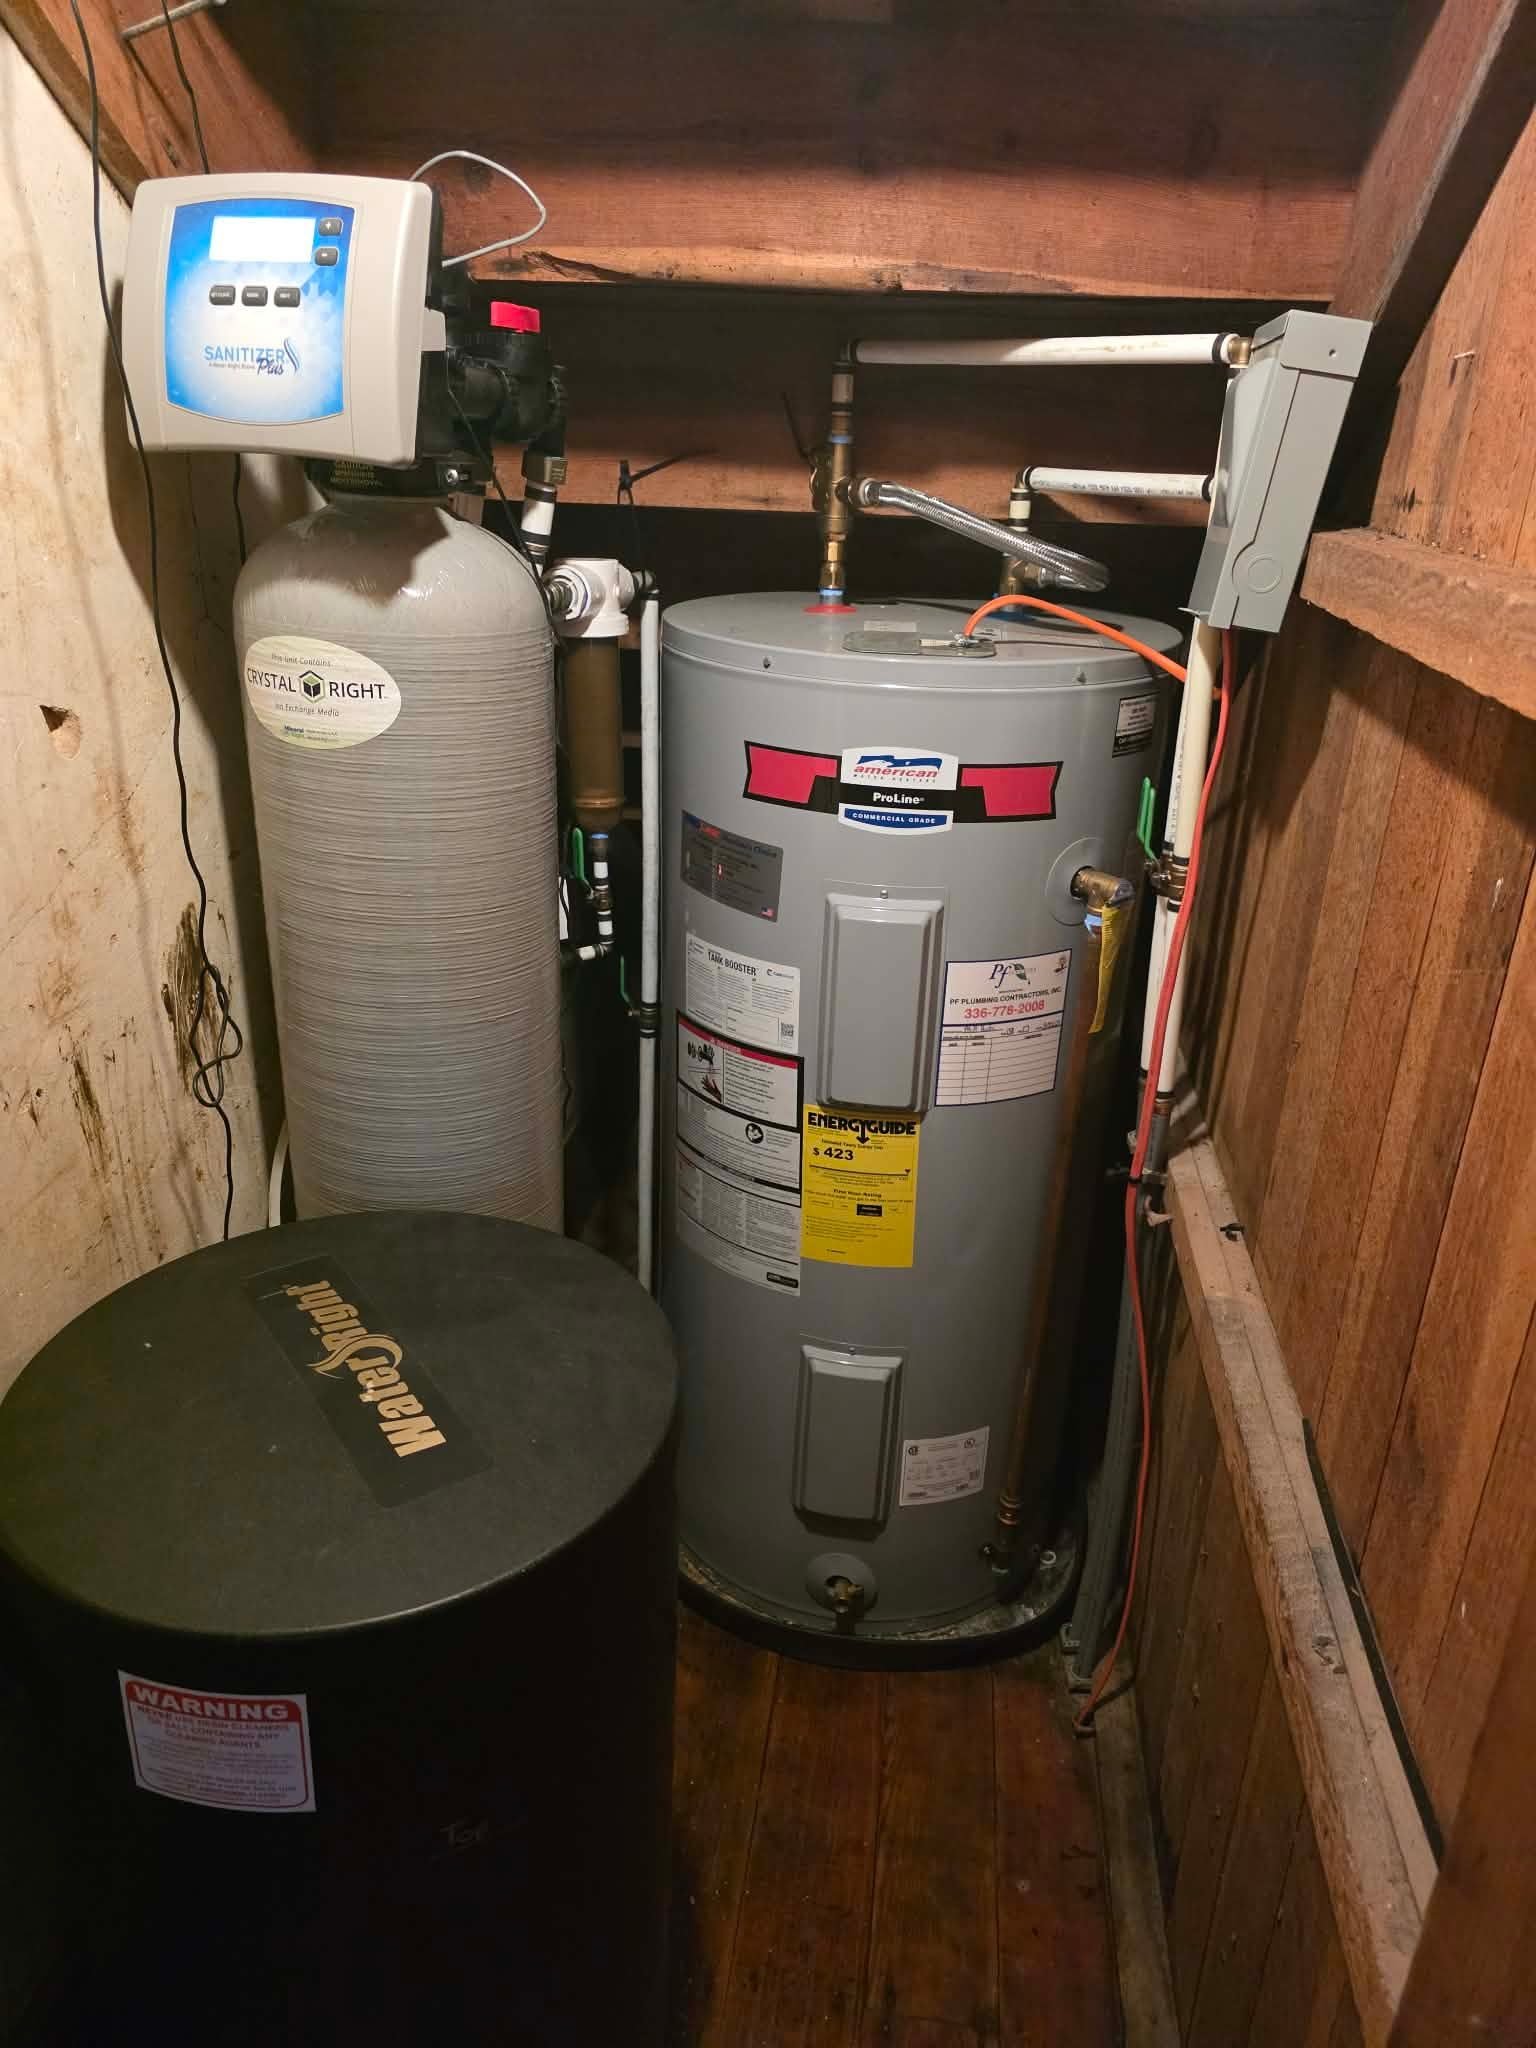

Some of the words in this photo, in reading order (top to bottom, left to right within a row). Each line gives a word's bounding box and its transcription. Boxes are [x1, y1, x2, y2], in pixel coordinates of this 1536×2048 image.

[204, 345, 286, 364] SANITIZER
[256, 357, 284, 376] Plus
[247, 667, 297, 693] CRYSTAL
[328, 681, 386, 700] RIGHT
[853, 765, 938, 778] american
[852, 812, 905, 823] COMMERCIAL
[707, 951, 724, 966] TANK
[961, 996, 999, 1005] PLUMBING
[823, 1146, 855, 1161] 423
[344, 1355, 447, 1457] Water
[132, 1684, 289, 1721] WARNING
